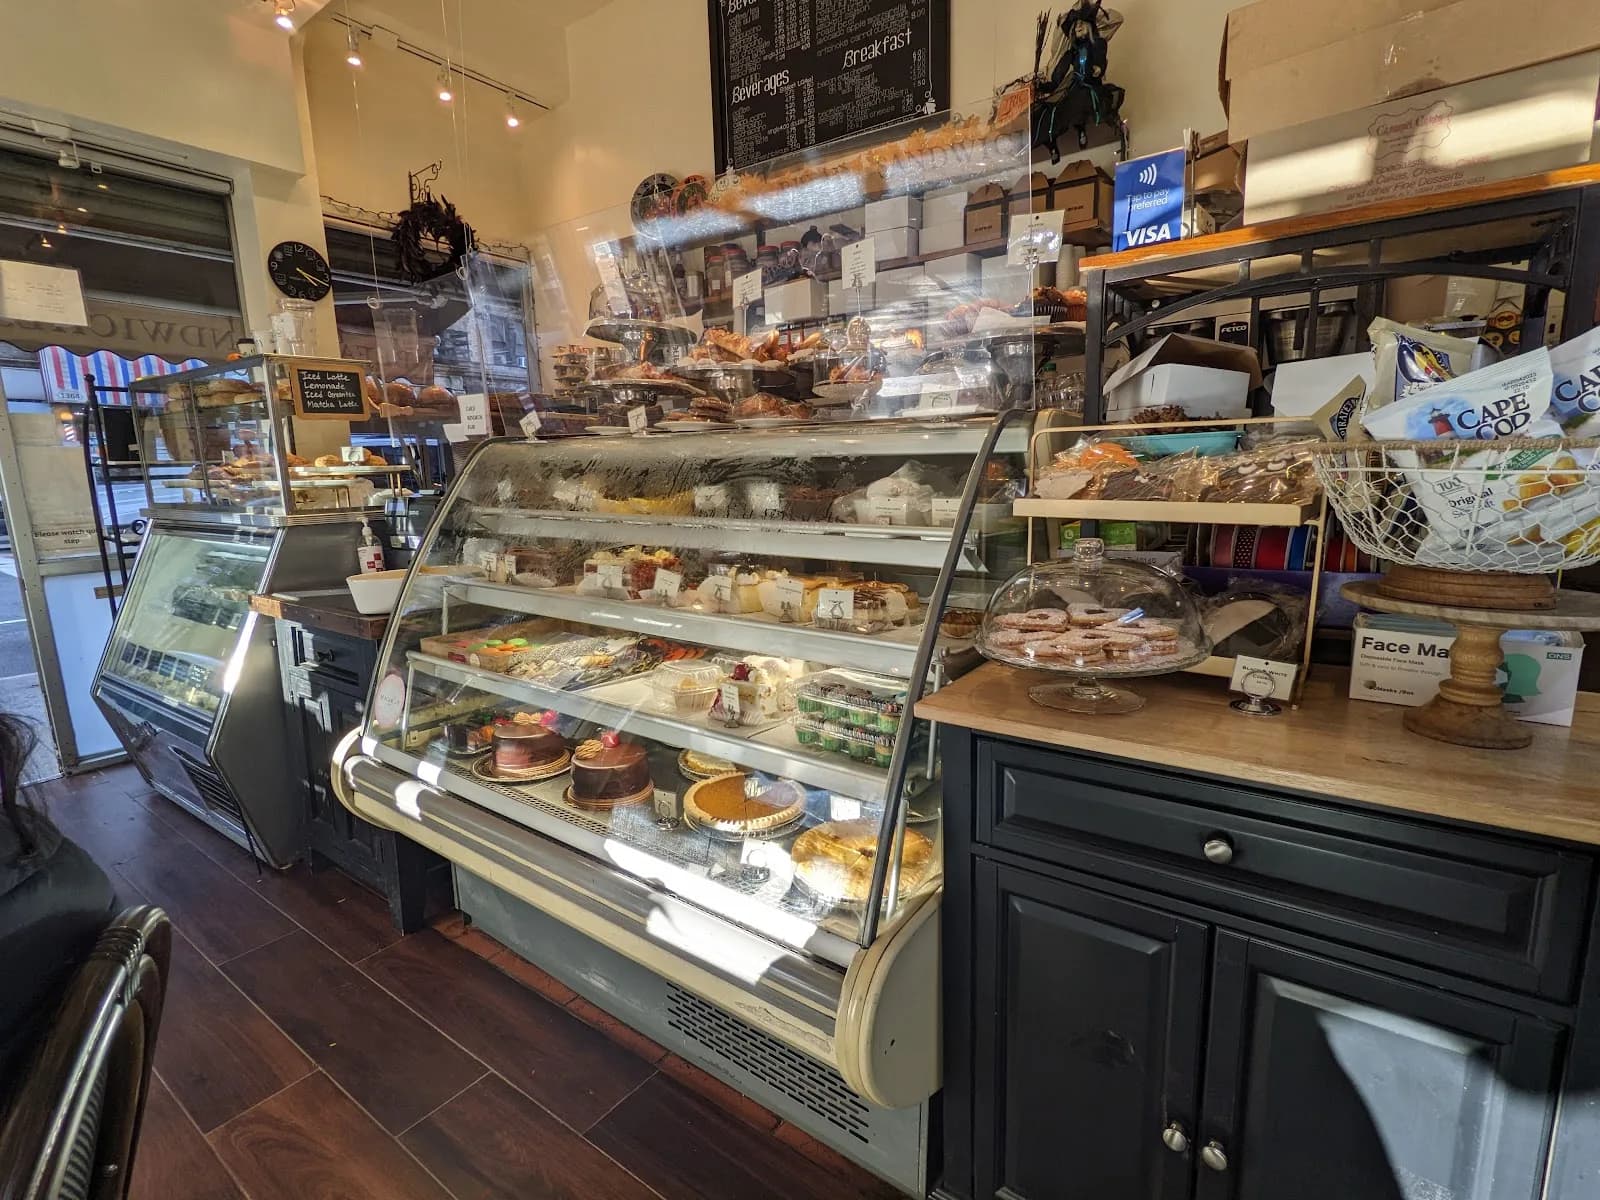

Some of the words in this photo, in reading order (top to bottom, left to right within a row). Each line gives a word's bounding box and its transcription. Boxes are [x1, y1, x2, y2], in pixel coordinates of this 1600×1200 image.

[842, 27, 912, 69] Breakfast
[731, 69, 790, 105] Beverages
[1127, 194, 1142, 203] Tap
[1143, 191, 1152, 199] to
[1153, 188, 1169, 198] pay
[1127, 195, 1168, 212] preferred
[1122, 223, 1171, 247] VISA
[294, 243, 304, 253] 12
[1221, 325, 1247, 333] FETCO
[300, 371, 321, 380] Iced
[326, 372, 350, 381] Latte
[303, 382, 346, 390] Lemonade
[307, 400, 336, 408] Matcha
[1457, 392, 1530, 430] CAPE
[1475, 412, 1531, 440] COD
[1448, 487, 1494, 509] Origial
[1361, 636, 1411, 655] Face
[1417, 642, 1450, 659] Ma
